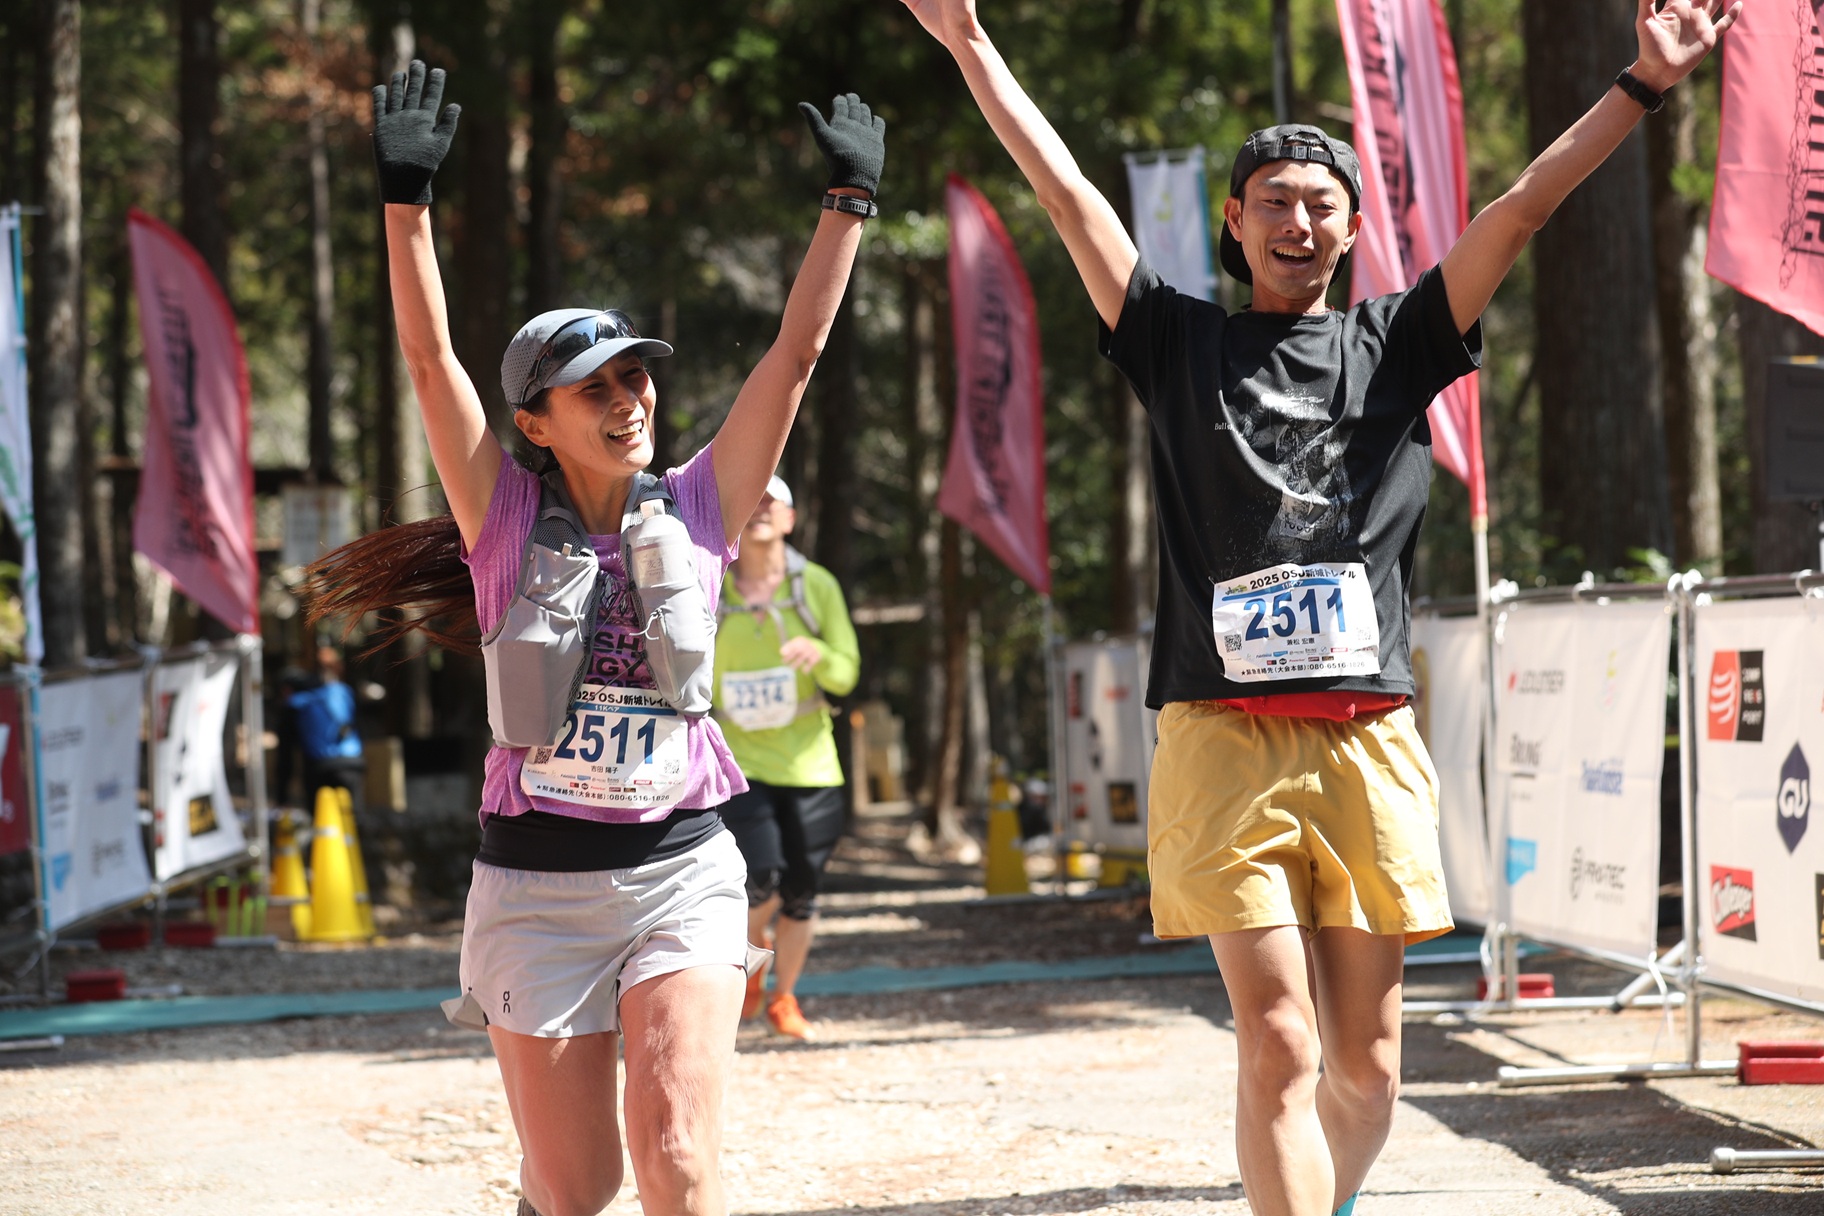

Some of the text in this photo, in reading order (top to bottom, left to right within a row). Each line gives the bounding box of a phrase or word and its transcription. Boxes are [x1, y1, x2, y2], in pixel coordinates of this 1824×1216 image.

[1250, 573, 1280, 590] 2025
[1243, 587, 1346, 641] 2511
[553, 713, 657, 765] 2511
[1780, 777, 1808, 819] GU
